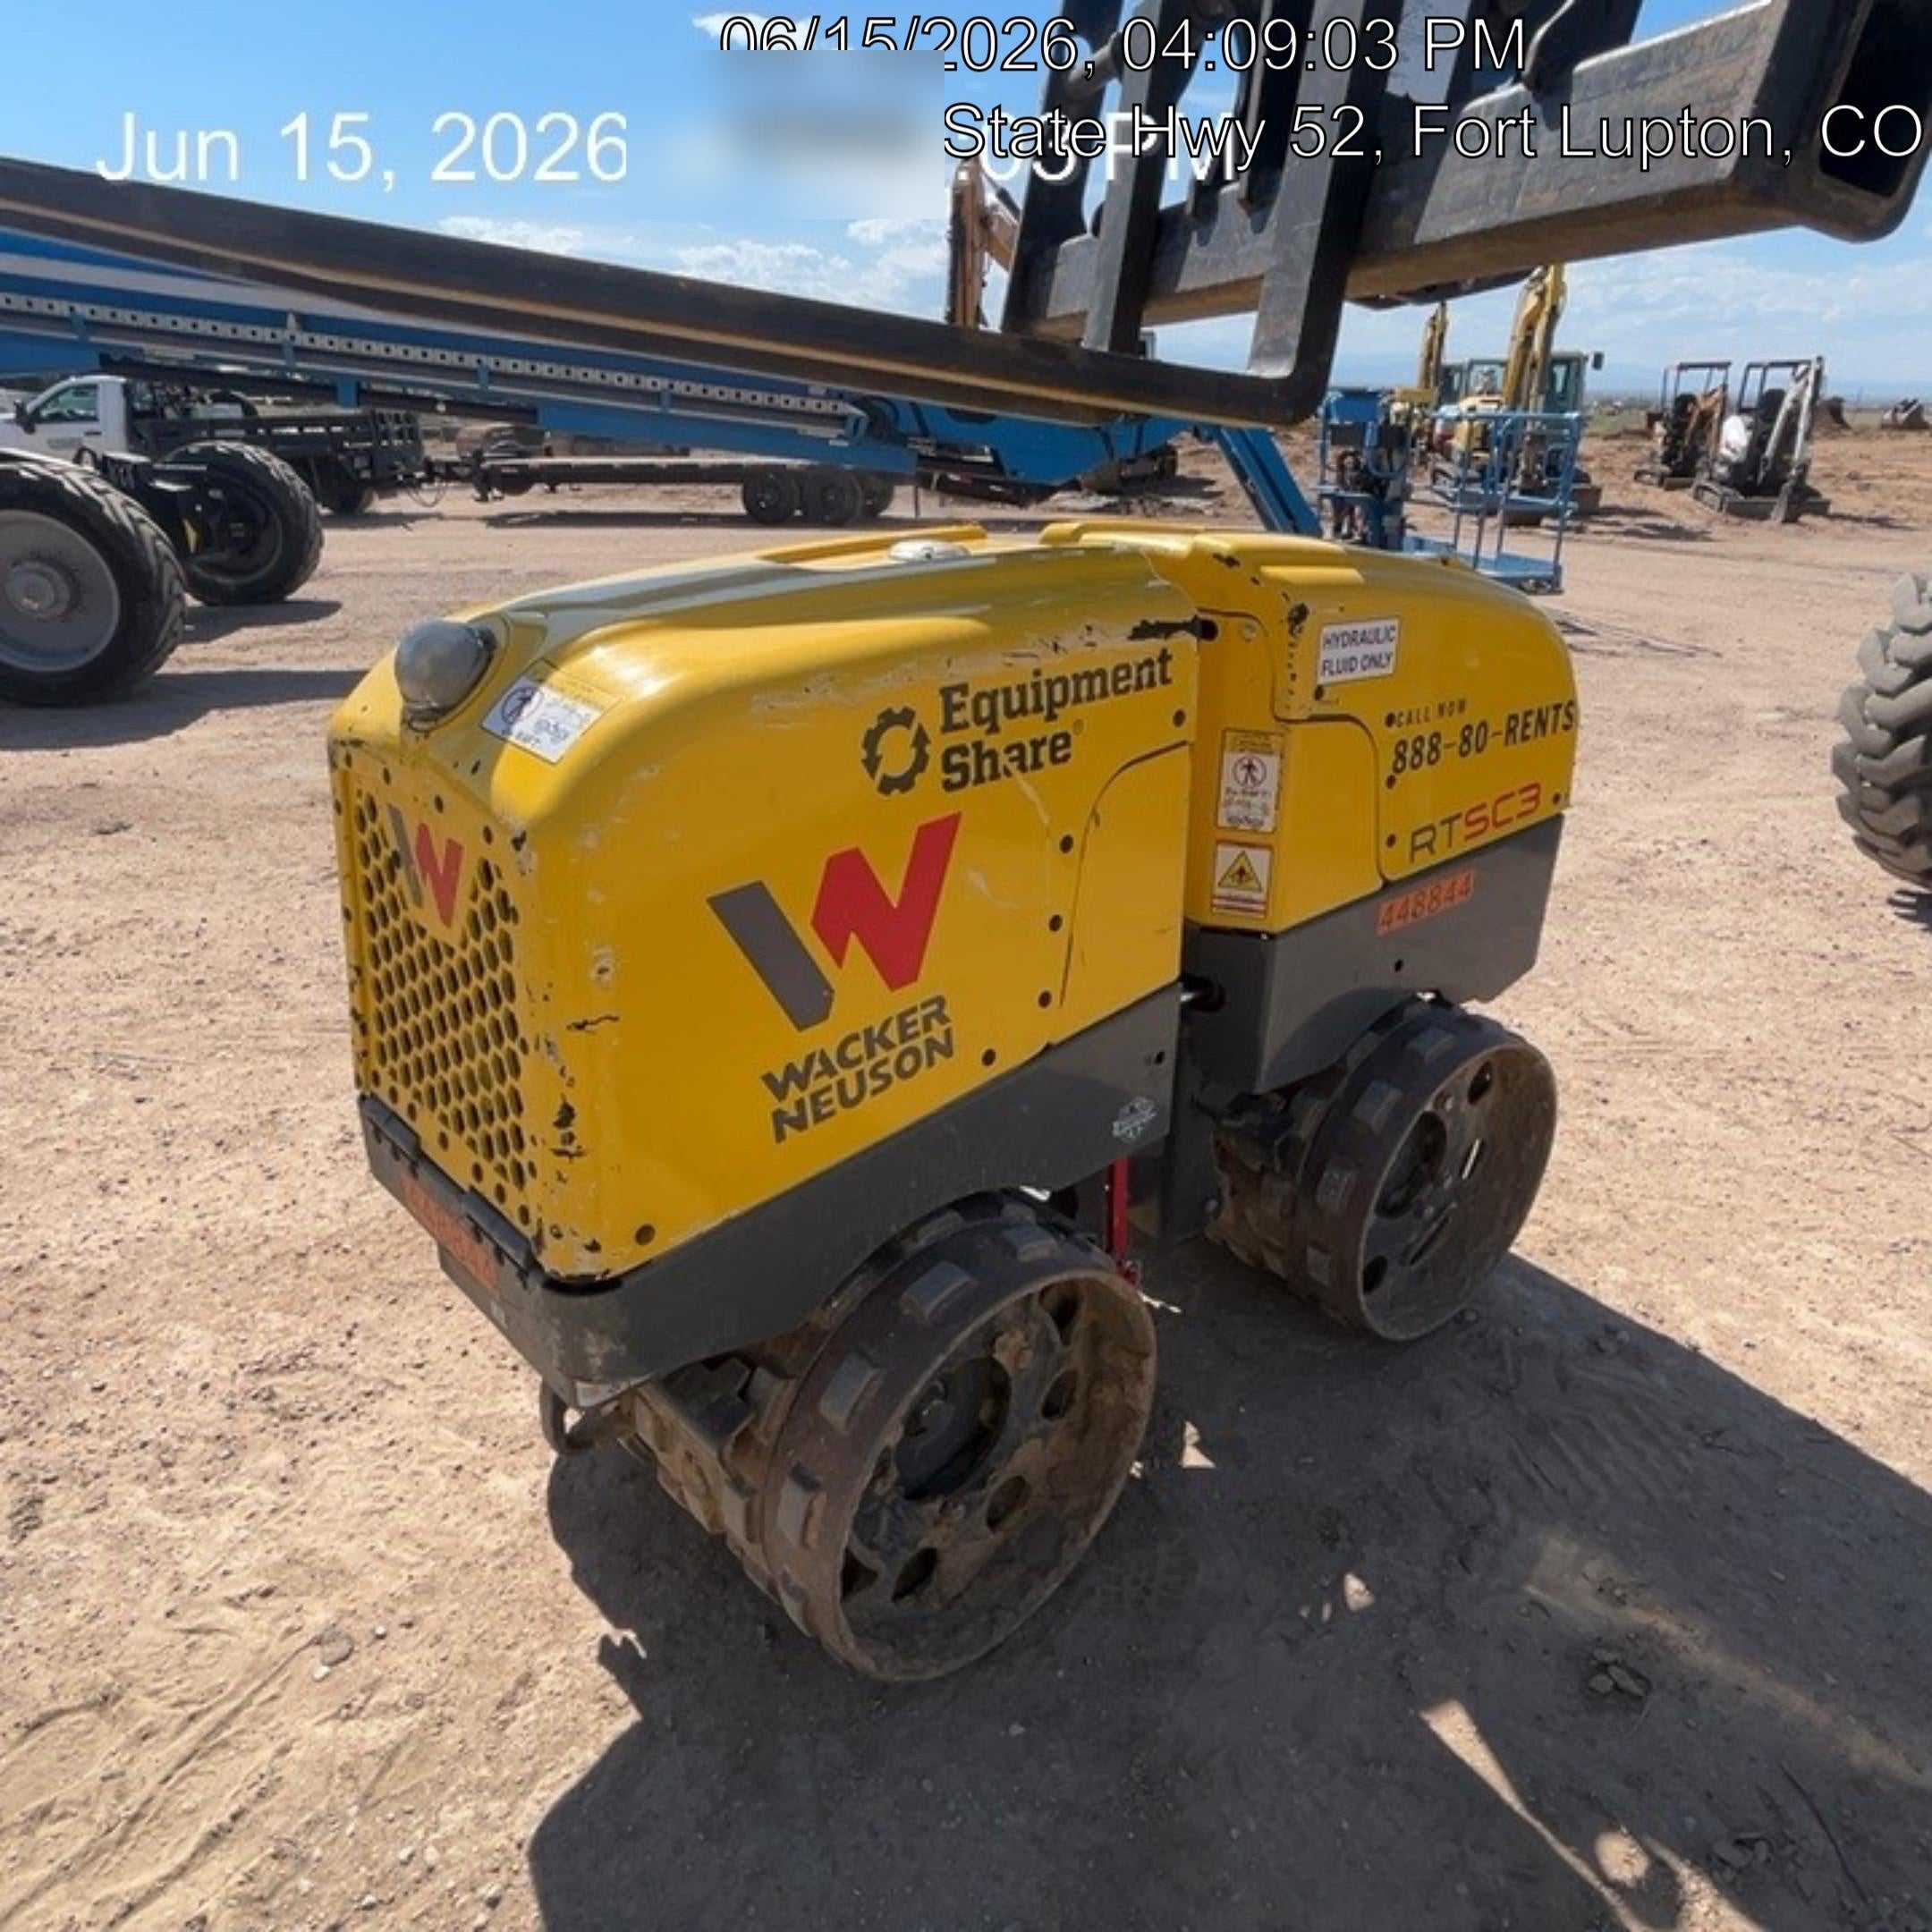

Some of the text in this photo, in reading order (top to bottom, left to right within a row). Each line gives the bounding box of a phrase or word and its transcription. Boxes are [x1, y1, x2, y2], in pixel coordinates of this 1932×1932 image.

[1322, 652, 1393, 676] FLUID ONLY
[1323, 624, 1396, 650] HYDRAULIC
[940, 648, 1173, 735] Equipment
[1396, 699, 1467, 728] CALL NOW
[1392, 699, 1576, 775] 888-80-RENTS
[761, 995, 951, 1104] WACKER
[772, 1028, 954, 1144] NEUSON
